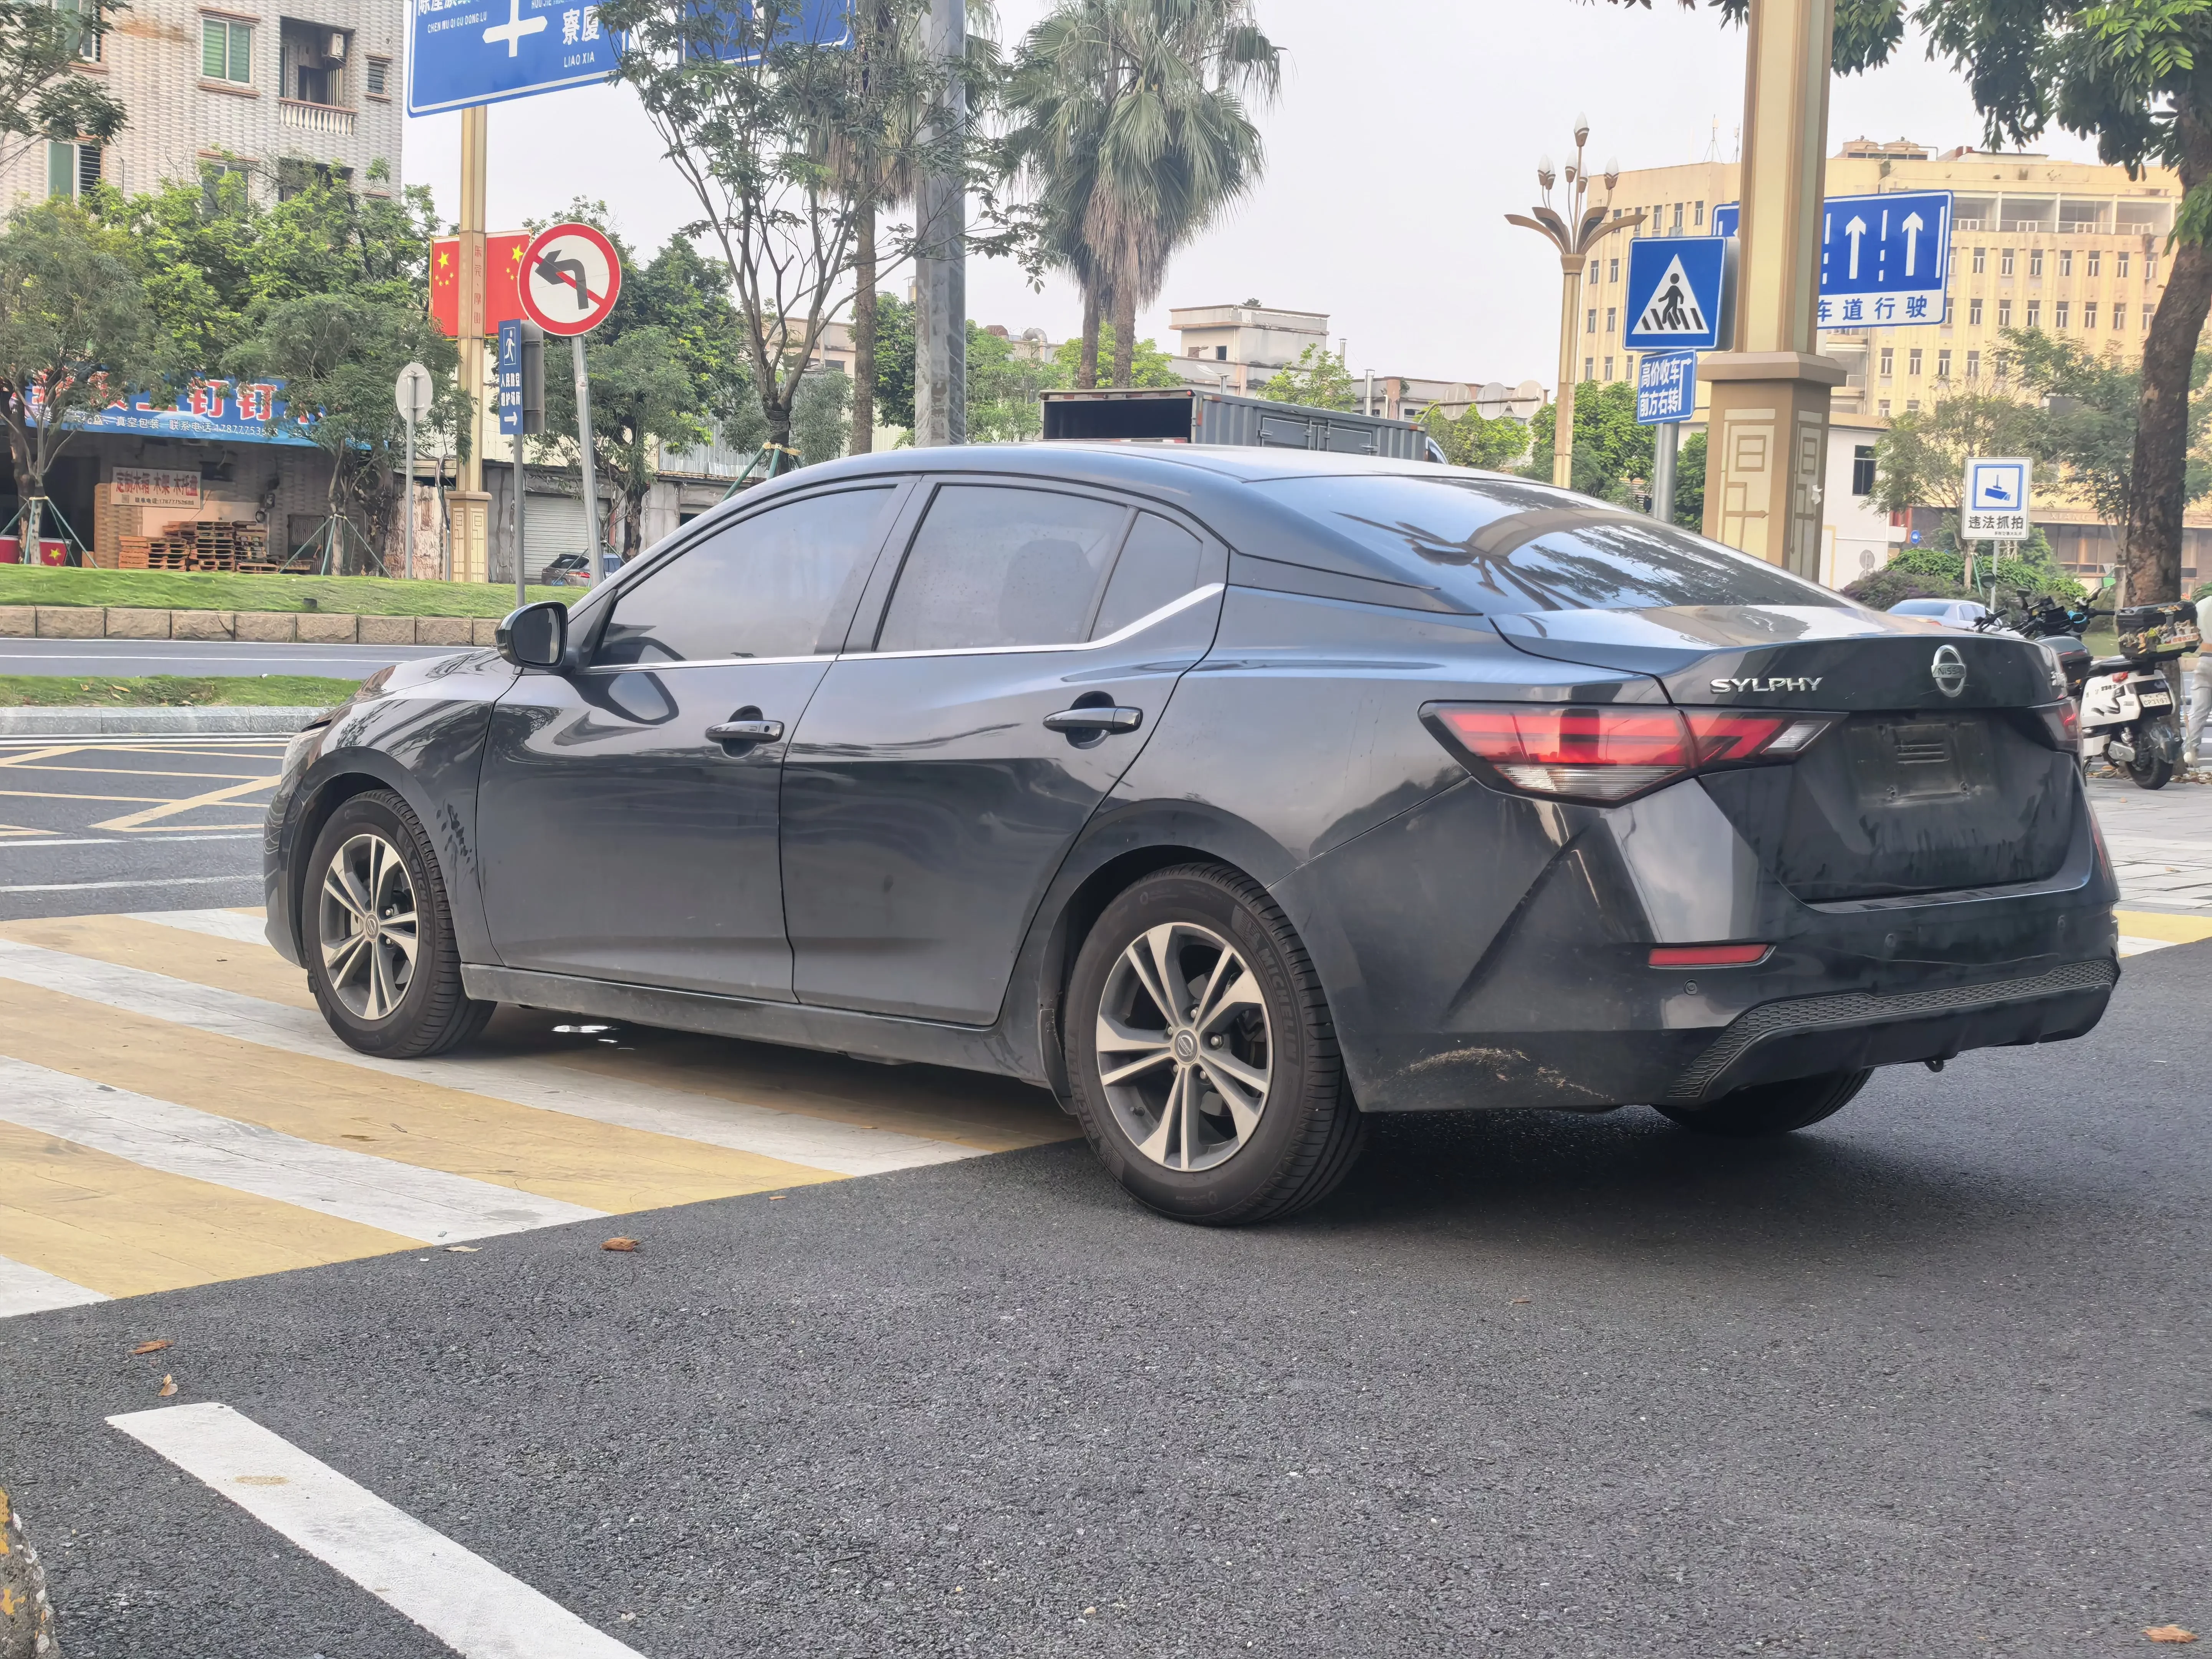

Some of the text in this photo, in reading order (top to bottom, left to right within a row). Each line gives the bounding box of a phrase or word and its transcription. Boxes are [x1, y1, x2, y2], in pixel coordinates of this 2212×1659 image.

[427, 21, 441, 33] CHEN
[562, 5, 600, 45] 寮厦
[564, 51, 595, 68] LIAO XIA
[1641, 357, 1681, 388] 高价收车
[1640, 387, 1679, 417] 前方右转
[1968, 515, 2023, 529] 违法抓拍
[1937, 666, 1965, 675] NISS
[1710, 677, 1823, 693] SYLPHY
